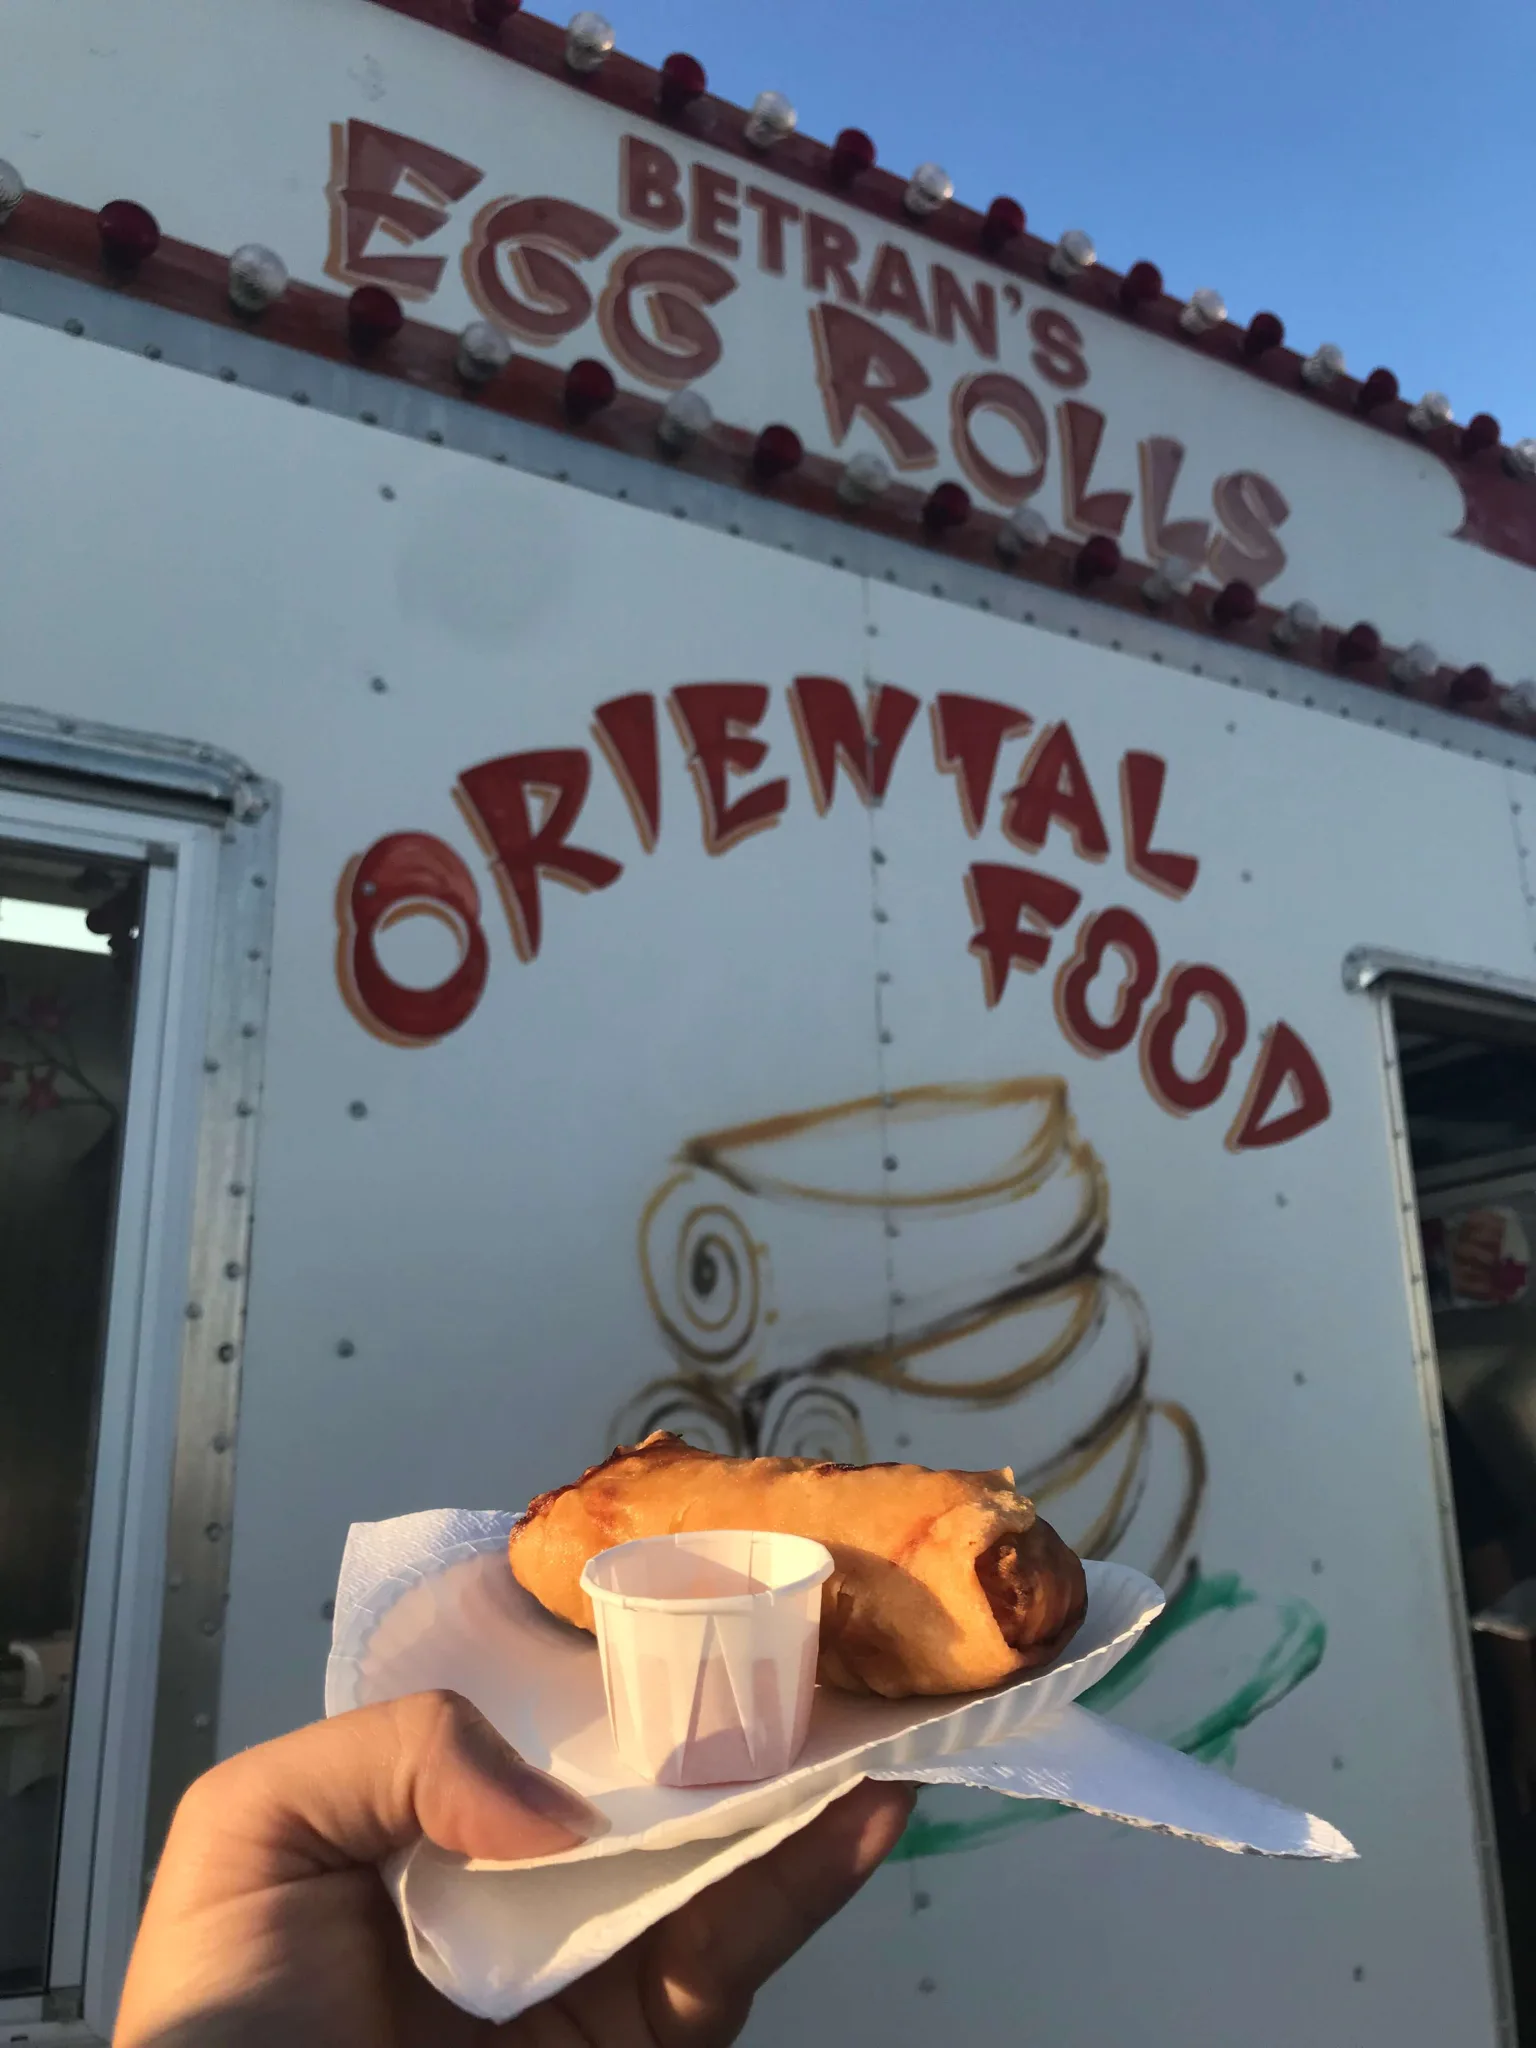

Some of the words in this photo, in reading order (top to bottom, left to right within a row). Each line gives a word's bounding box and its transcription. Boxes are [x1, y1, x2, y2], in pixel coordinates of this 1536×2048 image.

[325, 118, 738, 387] EGG
[810, 303, 1290, 588] ROLLS
[619, 134, 1089, 390] BETRAN'S
[335, 676, 1199, 1048] ORIENTAL
[963, 862, 1330, 1153] FOOD
